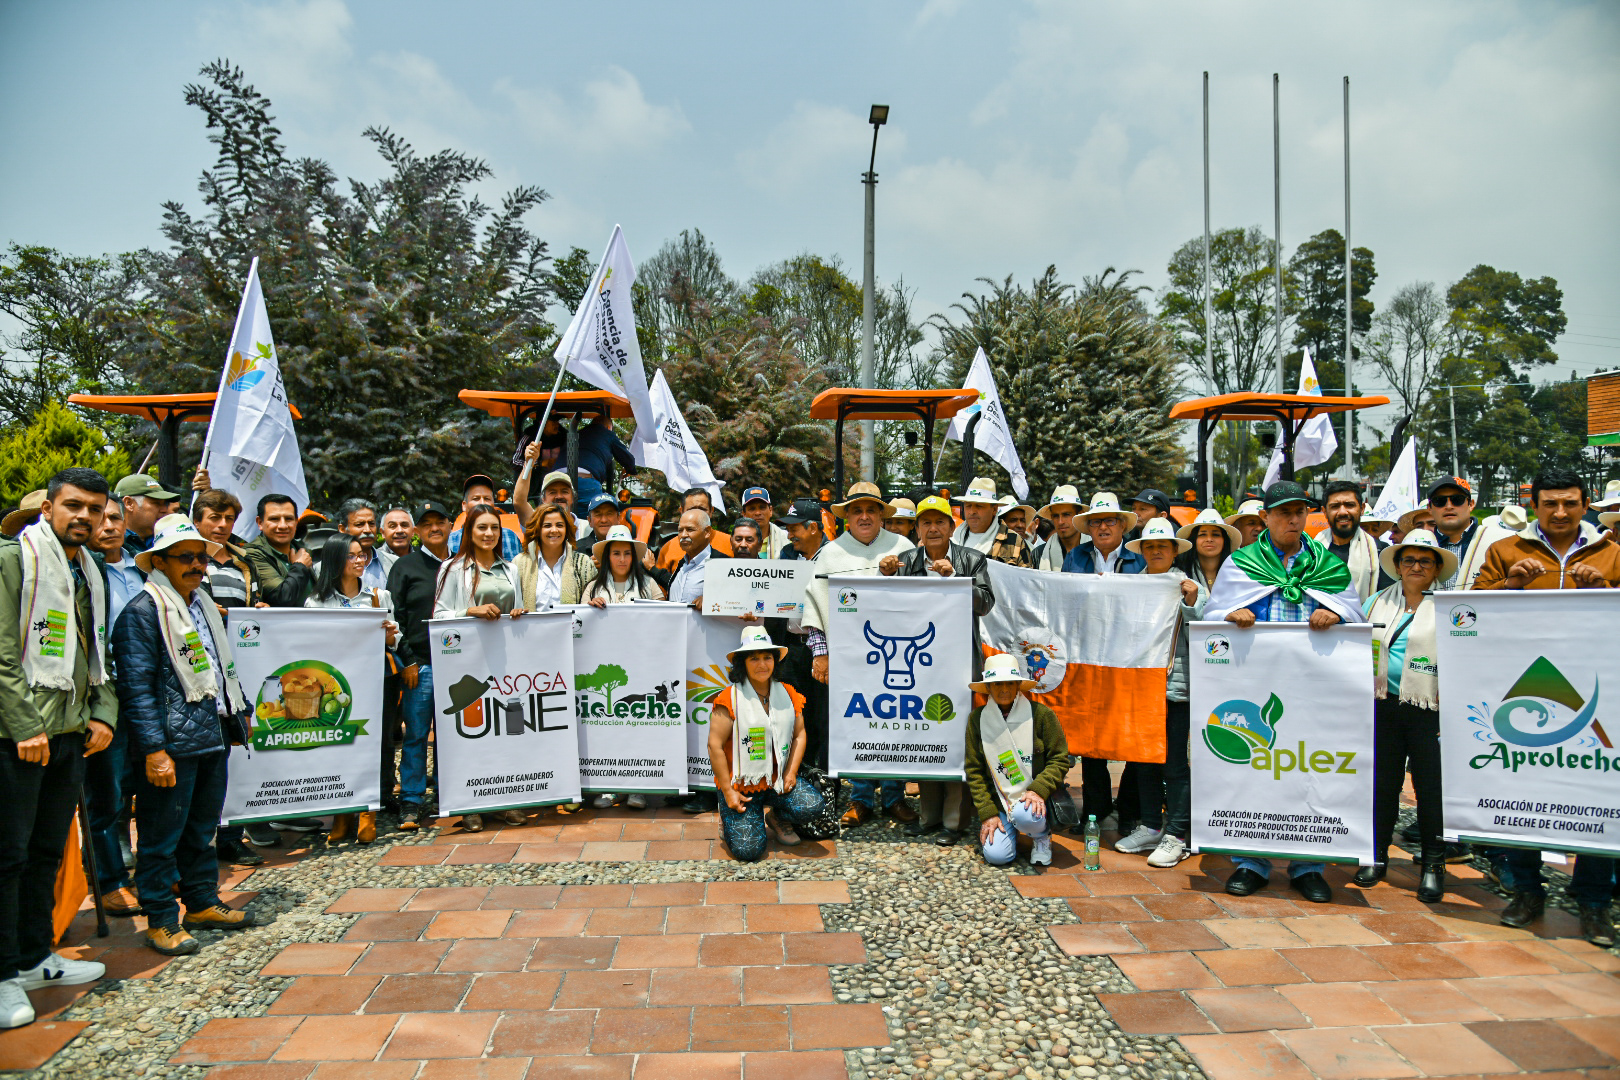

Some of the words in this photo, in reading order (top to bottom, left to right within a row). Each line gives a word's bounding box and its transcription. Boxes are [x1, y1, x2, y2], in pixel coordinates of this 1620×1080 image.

[599, 354, 612, 370] del
[616, 348, 628, 366] de
[728, 568, 794, 580] ASOGAUNE
[751, 582, 770, 590] UNE
[491, 671, 567, 695] ASOGA
[455, 691, 568, 739] UNE
[626, 719, 682, 727] Agroecológica
[868, 722, 930, 731] MADRID
[264, 729, 344, 746] APROPALEC
[852, 741, 890, 751] ASOCIACIÓN
[892, 743, 900, 751] DE
[901, 743, 948, 752] PRODUCTORES
[618, 758, 656, 766] MULTIACTIVA
[854, 753, 908, 763] AGROPECUARIOS
[909, 755, 918, 763] DE
[918, 755, 946, 764] MADRID
[1251, 740, 1357, 780] aplez
[261, 778, 294, 788] ASOCIACIÓN
[303, 775, 341, 785] PRODUCTORES
[466, 775, 504, 787] ASOCIACIÓN
[506, 774, 514, 783] DE
[516, 771, 554, 782] GANADEROS
[256, 790, 263, 798] DE
[264, 789, 280, 797] PAPA,
[282, 787, 299, 796] LECHE,
[300, 785, 323, 794] CEBOLLA
[328, 783, 345, 791] OTROS
[478, 784, 524, 797] AGRICULTORES
[526, 784, 534, 792] DE
[536, 782, 548, 790] UNE
[246, 798, 279, 807] PRODUCTOS
[306, 793, 318, 802] FRÍO
[334, 790, 354, 798] CALERA
[1478, 798, 1533, 812] ASOCIACIÓN
[1535, 803, 1548, 813] DE
[1549, 804, 1620, 819] PRODUCTORES
[1212, 810, 1252, 819] ASOCIACIÓN
[1253, 812, 1262, 820] DE
[1263, 813, 1312, 823] PRODUCTORES
[1313, 815, 1322, 824] DE
[1323, 816, 1343, 826] PAPA,
[1494, 815, 1506, 825] DE
[1508, 817, 1536, 828] LECHE
[1538, 819, 1551, 829] DE
[1553, 820, 1605, 834] CHOCONTÁ
[1208, 819, 1228, 827] LECHE
[1234, 820, 1256, 829] OTROS
[1257, 822, 1298, 832] PRODUCTOS
[1299, 824, 1308, 832] DE
[1309, 825, 1330, 834] CLIMA
[1332, 825, 1348, 835] FRÍO
[1224, 829, 1232, 837] DE
[1233, 830, 1270, 840] ZIPAQUIRÁ
[1276, 833, 1303, 842] SABANA
[1304, 835, 1332, 843] CENTRO
